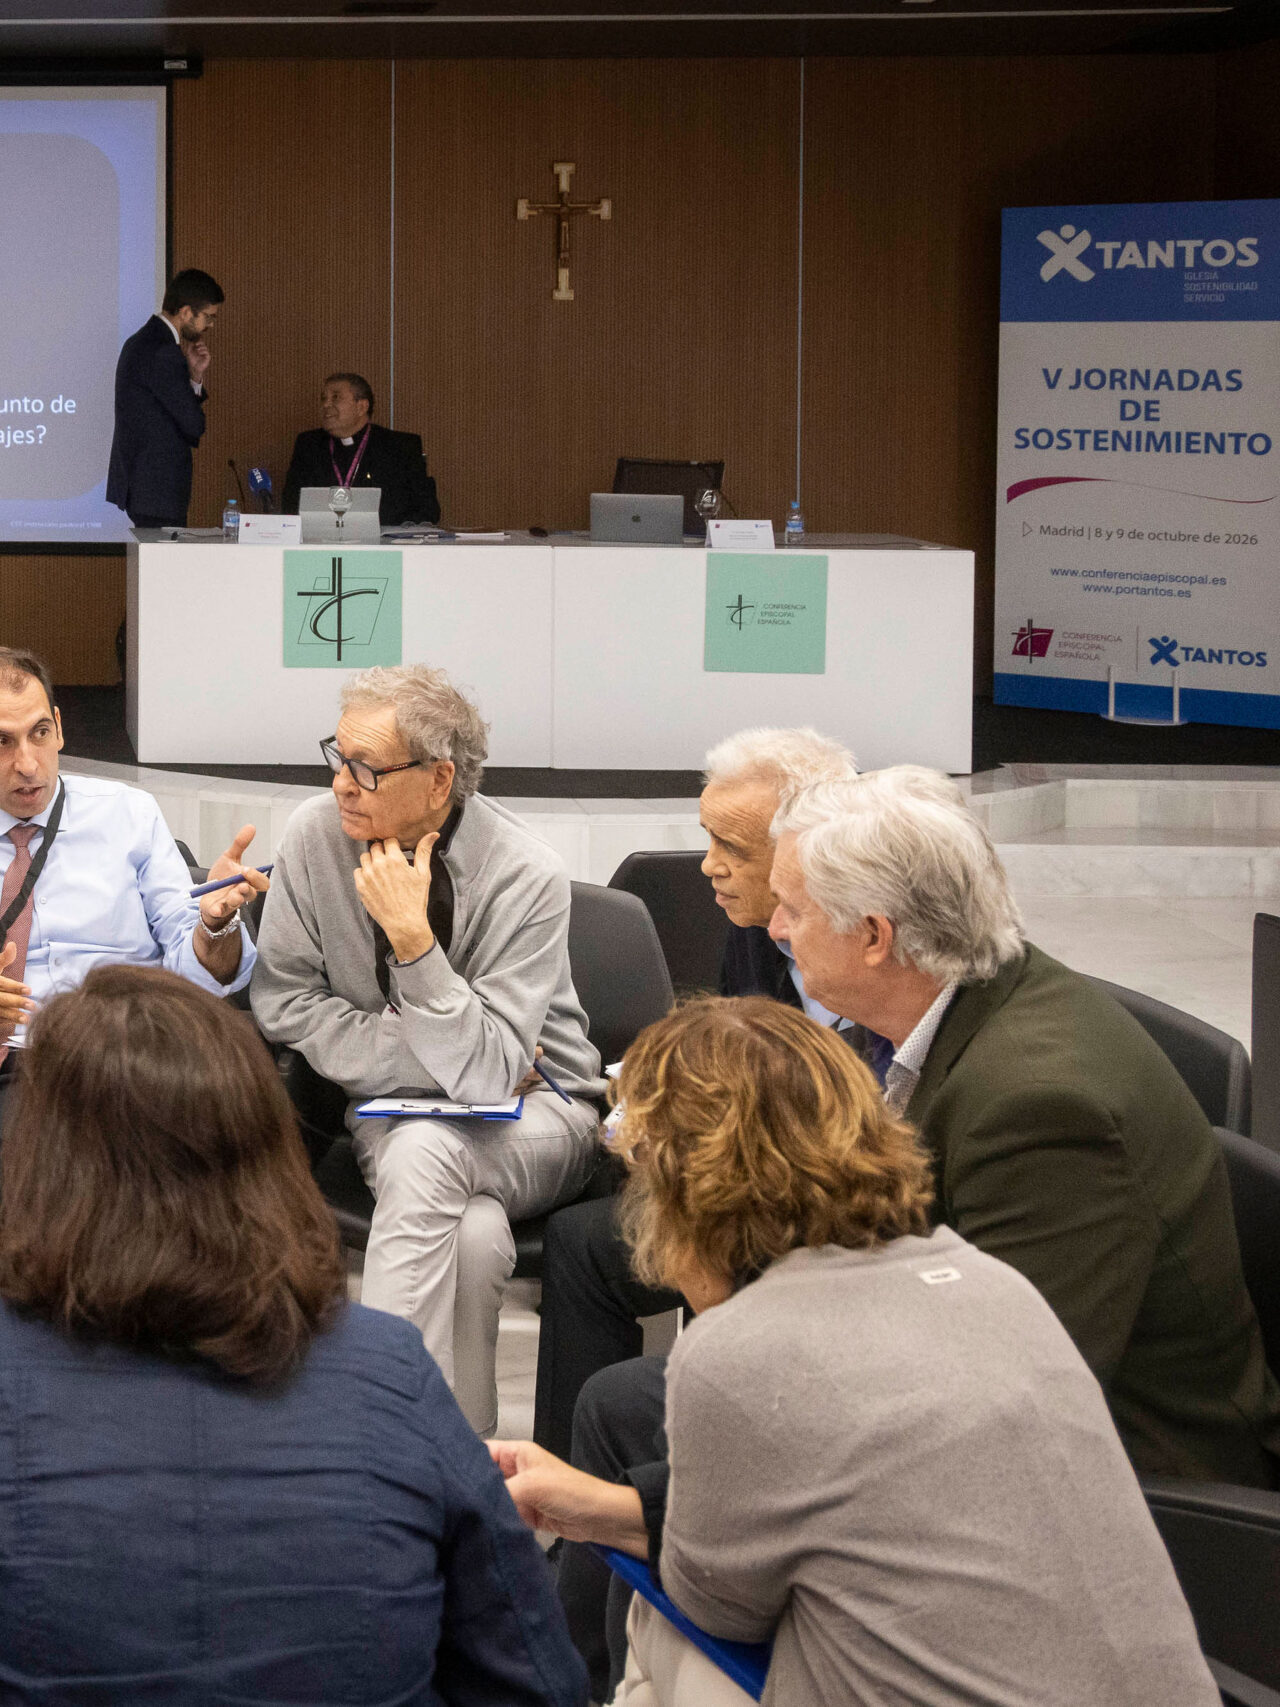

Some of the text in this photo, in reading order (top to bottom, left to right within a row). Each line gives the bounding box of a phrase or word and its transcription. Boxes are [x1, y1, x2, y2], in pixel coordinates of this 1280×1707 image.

[1041, 367, 1243, 392] V JORNADAS
[50, 394, 77, 414] de
[1119, 399, 1161, 422] DE
[1014, 427, 1272, 456] SOSTENIMIENTO
[1039, 524, 1085, 538] Madrid
[1094, 527, 1103, 539] 8
[1105, 530, 1113, 541] y
[1116, 528, 1125, 540] 9
[1127, 528, 1145, 541] de
[1147, 529, 1201, 544] octubre
[1203, 531, 1221, 545] de
[1224, 533, 1259, 546] 2026
[1050, 567, 1227, 585] www.conferenciaepiscopal.es
[1083, 583, 1192, 598] www.portantos.es
[1062, 631, 1122, 642] CONFERENCIA
